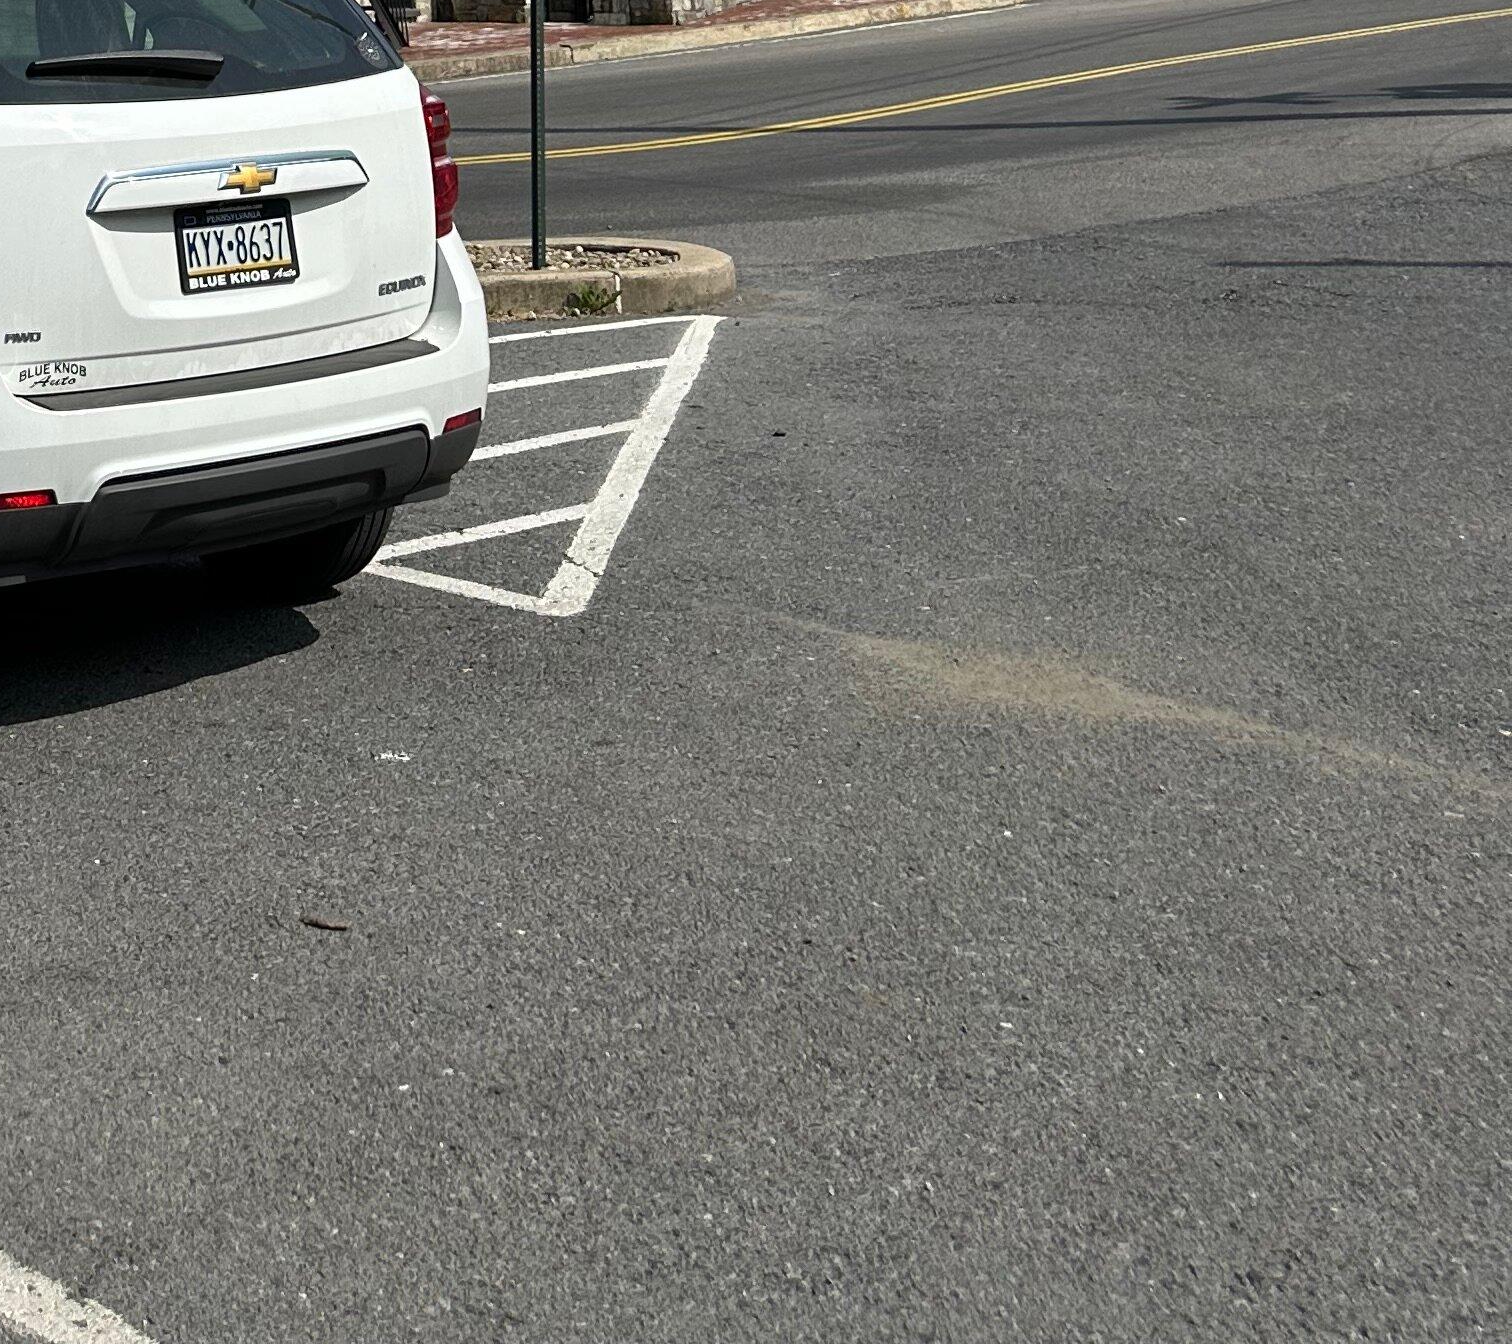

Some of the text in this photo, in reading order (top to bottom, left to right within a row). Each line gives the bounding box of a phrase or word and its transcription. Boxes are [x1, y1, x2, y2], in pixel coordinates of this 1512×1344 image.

[188, 267, 297, 290] BLUE KNOB Auto
[18, 361, 87, 383] BLUE KNOB
[29, 374, 77, 389] Auto
